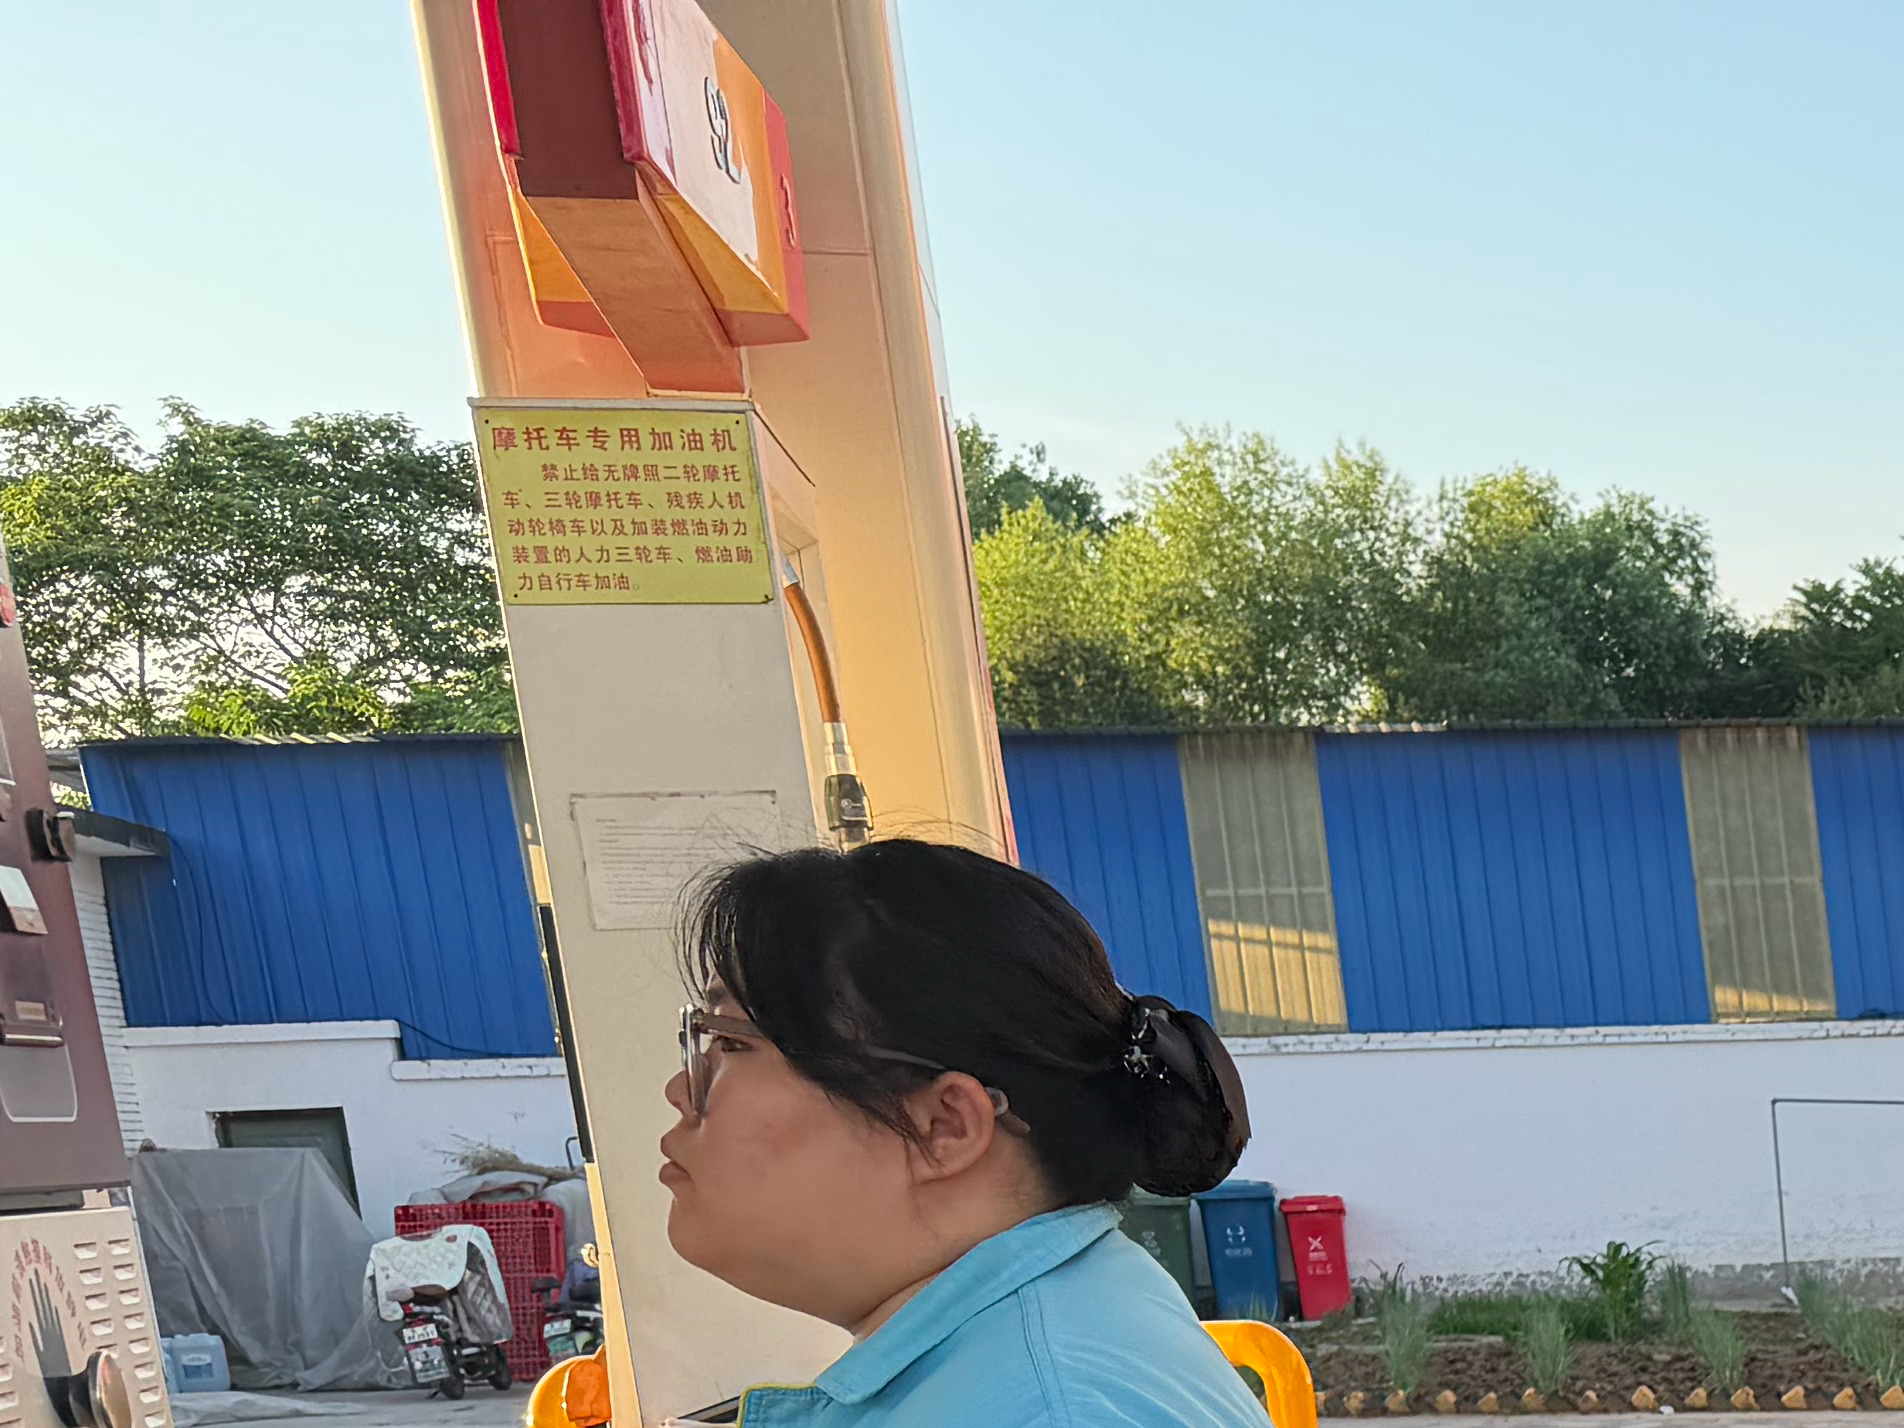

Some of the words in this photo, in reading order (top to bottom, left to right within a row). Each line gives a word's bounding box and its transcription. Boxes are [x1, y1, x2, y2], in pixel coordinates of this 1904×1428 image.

[491, 427, 737, 452] 摩托车专用加油机
[541, 463, 741, 483] 禁止给无牌照二轮摩托
[502, 490, 745, 510] 车、三轮摩托车、残疾人机
[507, 518, 747, 537] 动轮椅车以及加装燃油动力
[512, 546, 753, 565] 装置的人力三轮车、燃油助
